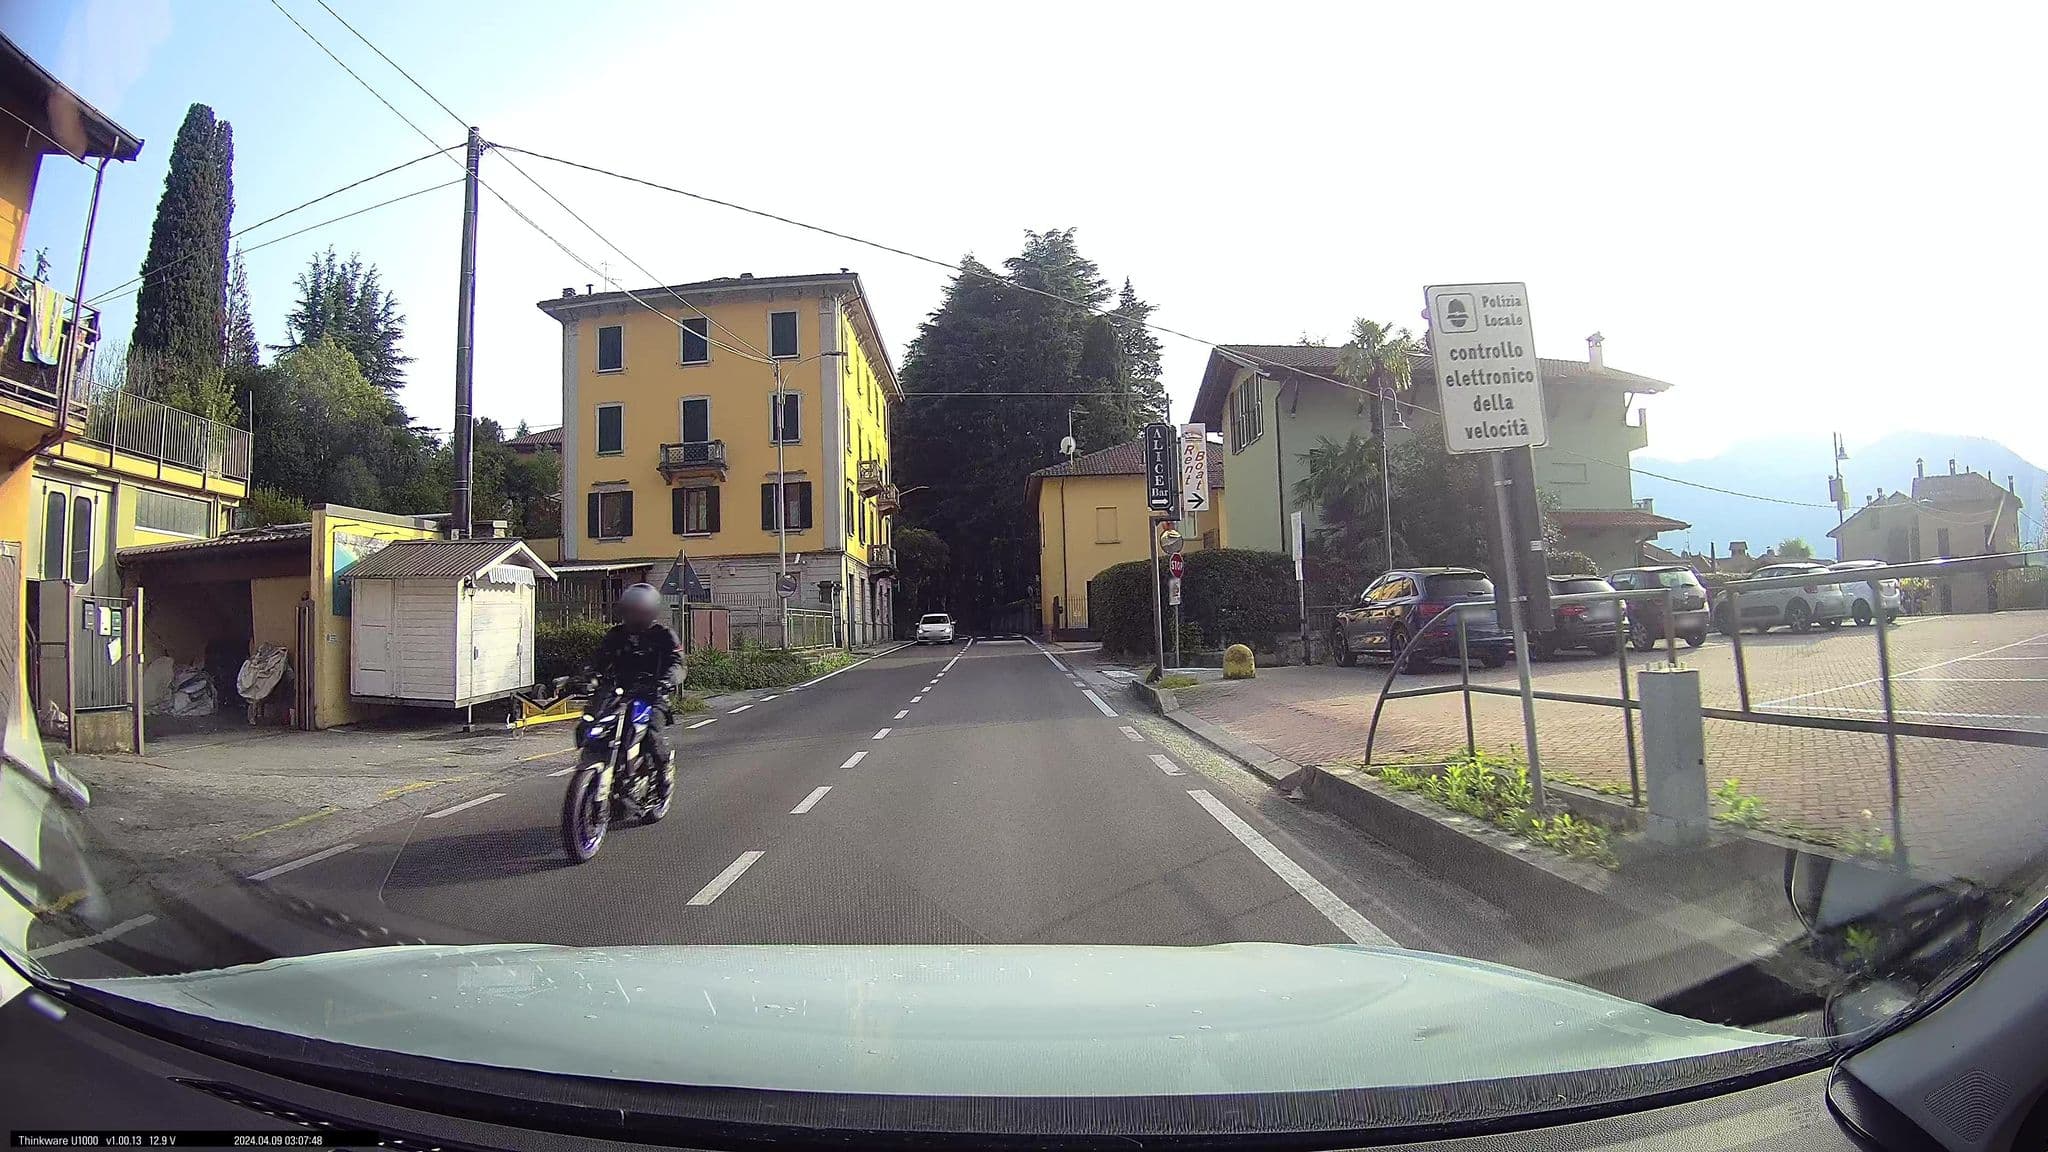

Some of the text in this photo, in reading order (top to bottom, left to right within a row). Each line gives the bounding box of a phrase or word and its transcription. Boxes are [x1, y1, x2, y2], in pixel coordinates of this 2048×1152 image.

[1482, 295, 1522, 308] Polizia
[1485, 314, 1523, 327] Locale
[1450, 341, 1523, 361] controllo
[1446, 366, 1534, 387] elettronico
[1473, 393, 1514, 412] della
[1464, 418, 1529, 439] velocità
[1153, 428, 1165, 486] ALICE
[1183, 444, 1195, 485] Rent
[1195, 451, 1205, 490] Boat
[1151, 487, 1169, 497] Bar
[1171, 560, 1183, 570] STOP
